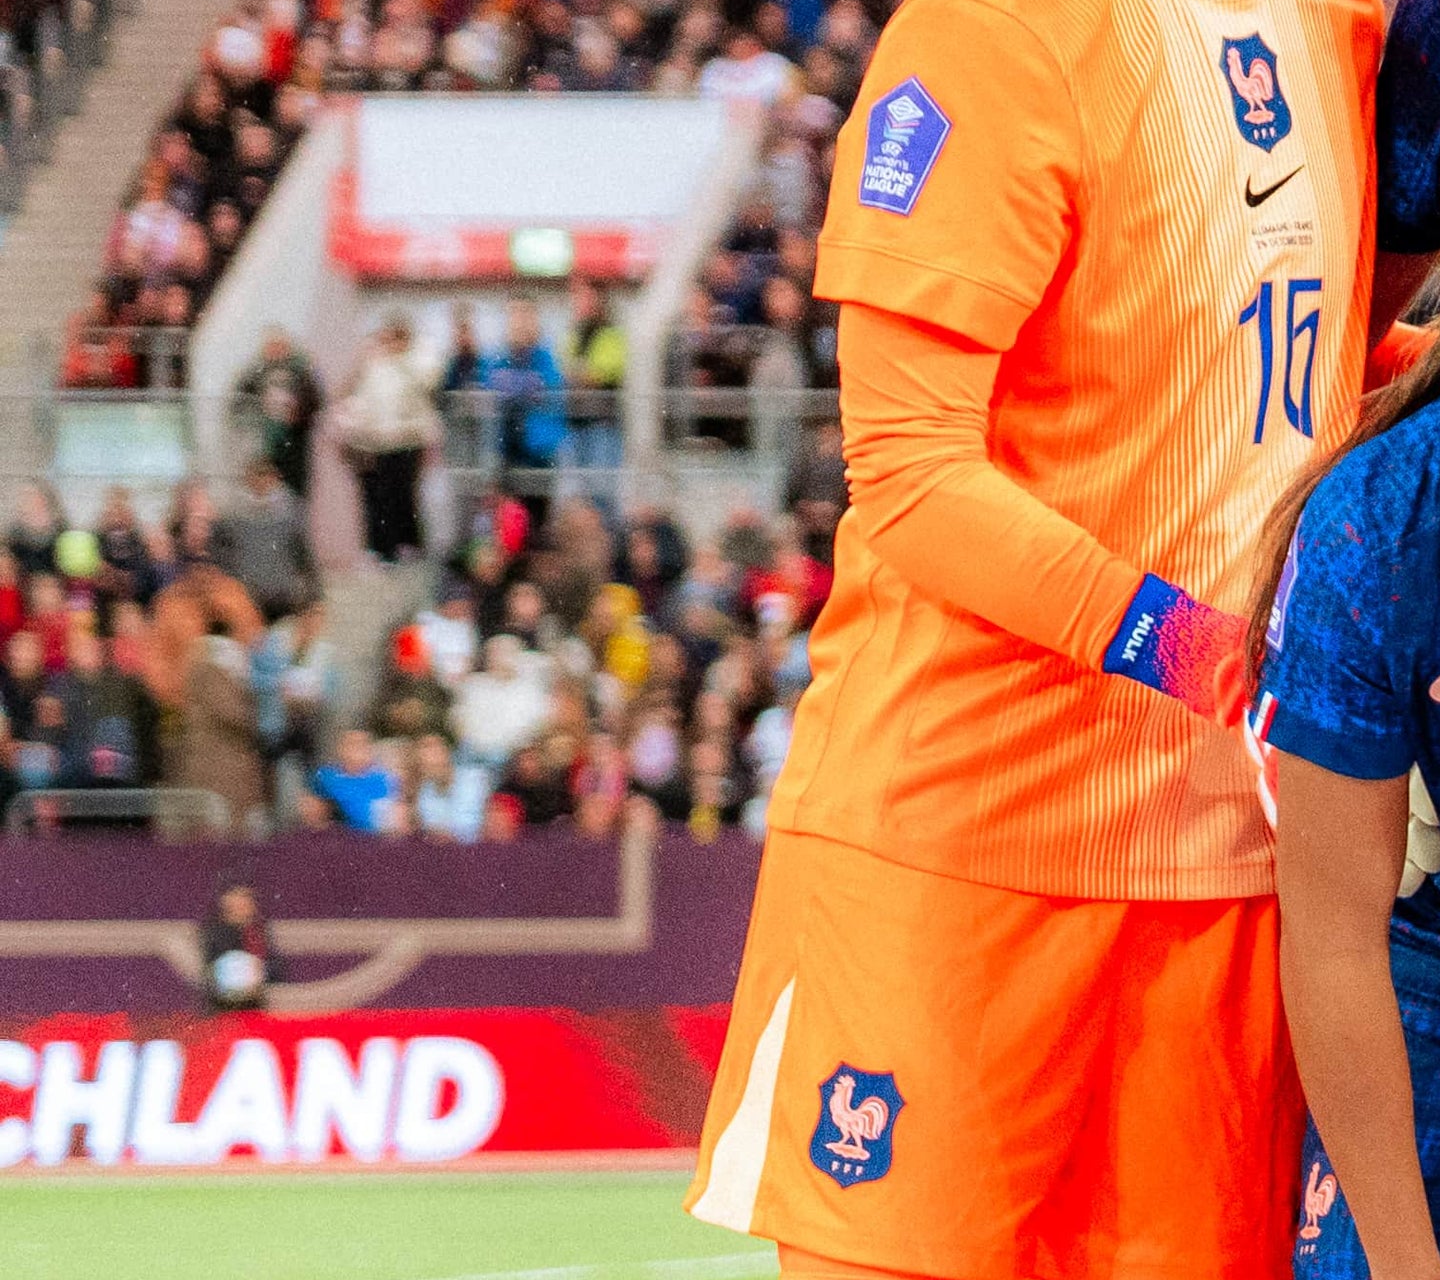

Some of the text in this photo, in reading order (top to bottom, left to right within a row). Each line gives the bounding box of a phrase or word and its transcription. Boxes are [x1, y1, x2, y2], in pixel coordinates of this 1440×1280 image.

[865, 165, 914, 186] NATIONS
[864, 178, 907, 198] LEAGUE
[1121, 612, 1154, 662] HULK
